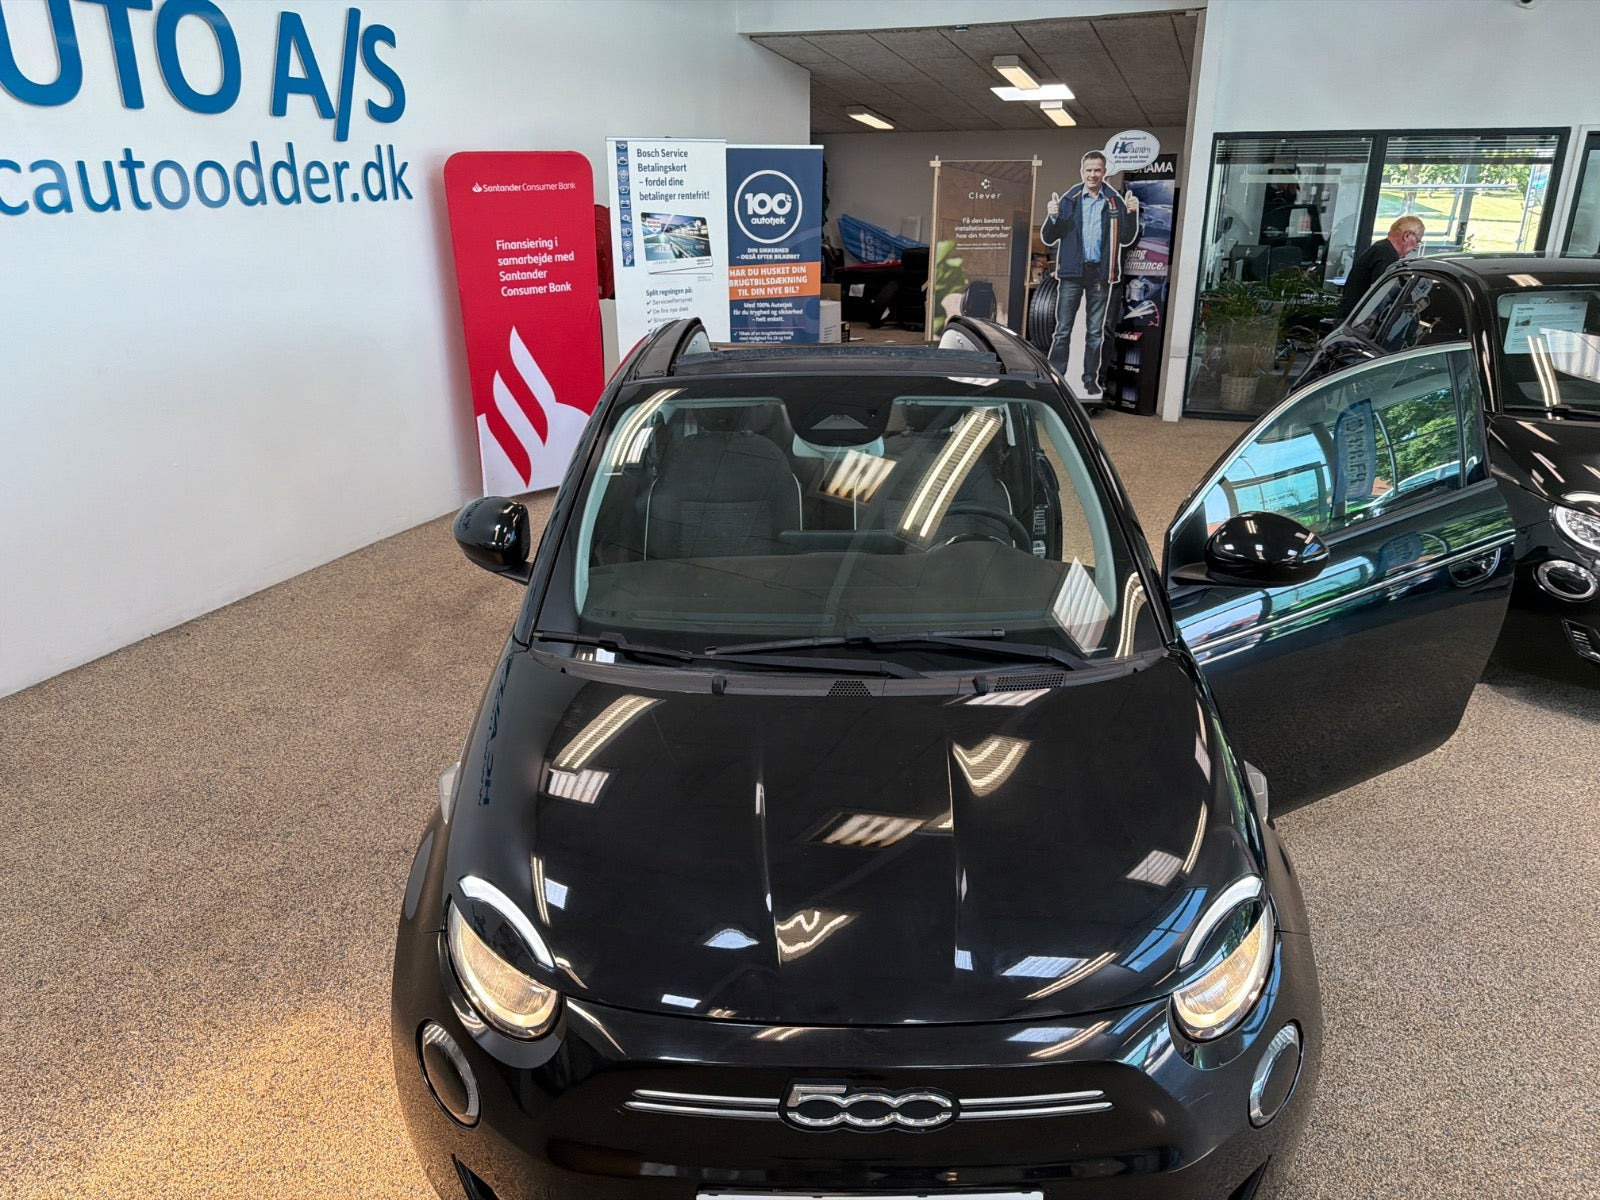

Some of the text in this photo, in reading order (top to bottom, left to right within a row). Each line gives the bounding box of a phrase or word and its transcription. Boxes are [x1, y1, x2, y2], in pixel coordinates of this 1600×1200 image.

[271, 7, 406, 142] A/S
[636, 148, 688, 158] Bosch Service
[638, 164, 687, 174] Betalingskort
[483, 184, 521, 192] Santander
[522, 183, 558, 191] Consumer
[645, 177, 667, 186] fordel
[669, 177, 684, 186] dine
[640, 191, 710, 202] betalinger rentefrit!
[496, 236, 558, 250] Finansiering i
[497, 250, 575, 266] samarbejde med
[499, 268, 548, 282] Santander
[729, 269, 746, 277] HAR
[760, 267, 790, 275] HUSKET
[501, 281, 572, 297] Consumer Bank
[786, 1083, 953, 1127] 500
